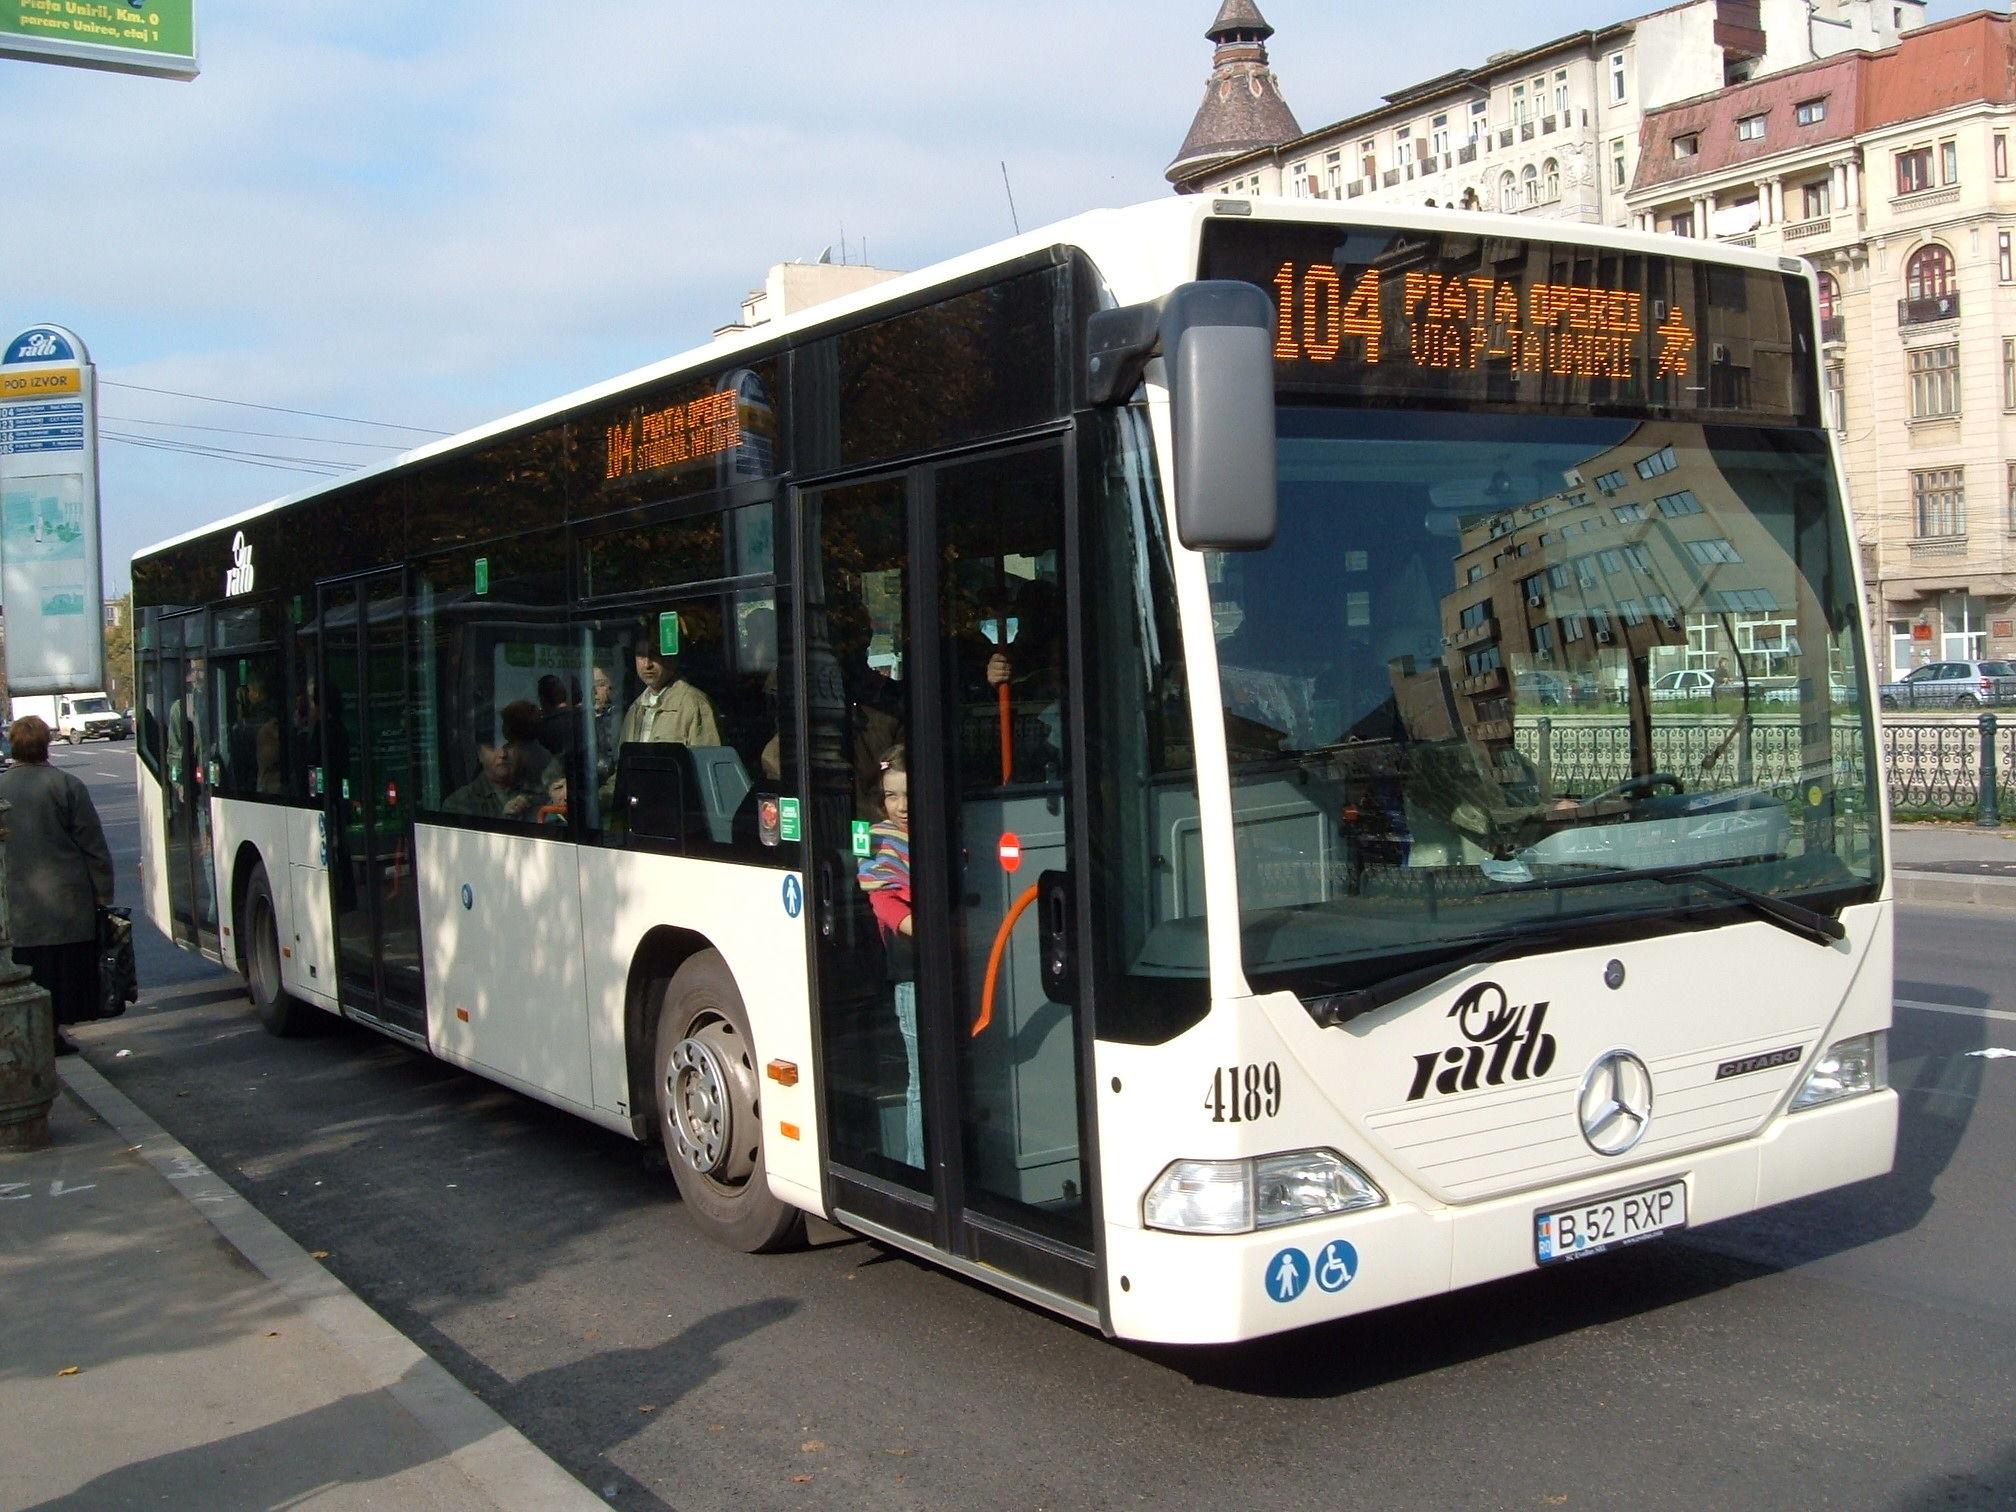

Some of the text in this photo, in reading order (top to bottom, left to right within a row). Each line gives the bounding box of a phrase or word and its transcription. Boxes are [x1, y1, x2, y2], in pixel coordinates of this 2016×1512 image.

[19, 15, 70, 31] parcare
[123, 28, 148, 43] etaj
[151, 31, 159, 42] 1
[116, 8, 145, 24] Km.
[1273, 260, 1641, 364] 104 PIATA OPEREI
[1411, 322, 1462, 369] VIA
[1549, 331, 1633, 378] UNIRII
[4, 376, 67, 390] POD IZVOR
[0, 407, 14, 418] 04
[1719, 1049, 1800, 1076] CITARO
[1204, 1061, 1281, 1122] 4189
[1558, 1214, 1576, 1249] B
[1586, 1206, 1615, 1242] 52
[1623, 1190, 1674, 1233] RXP
